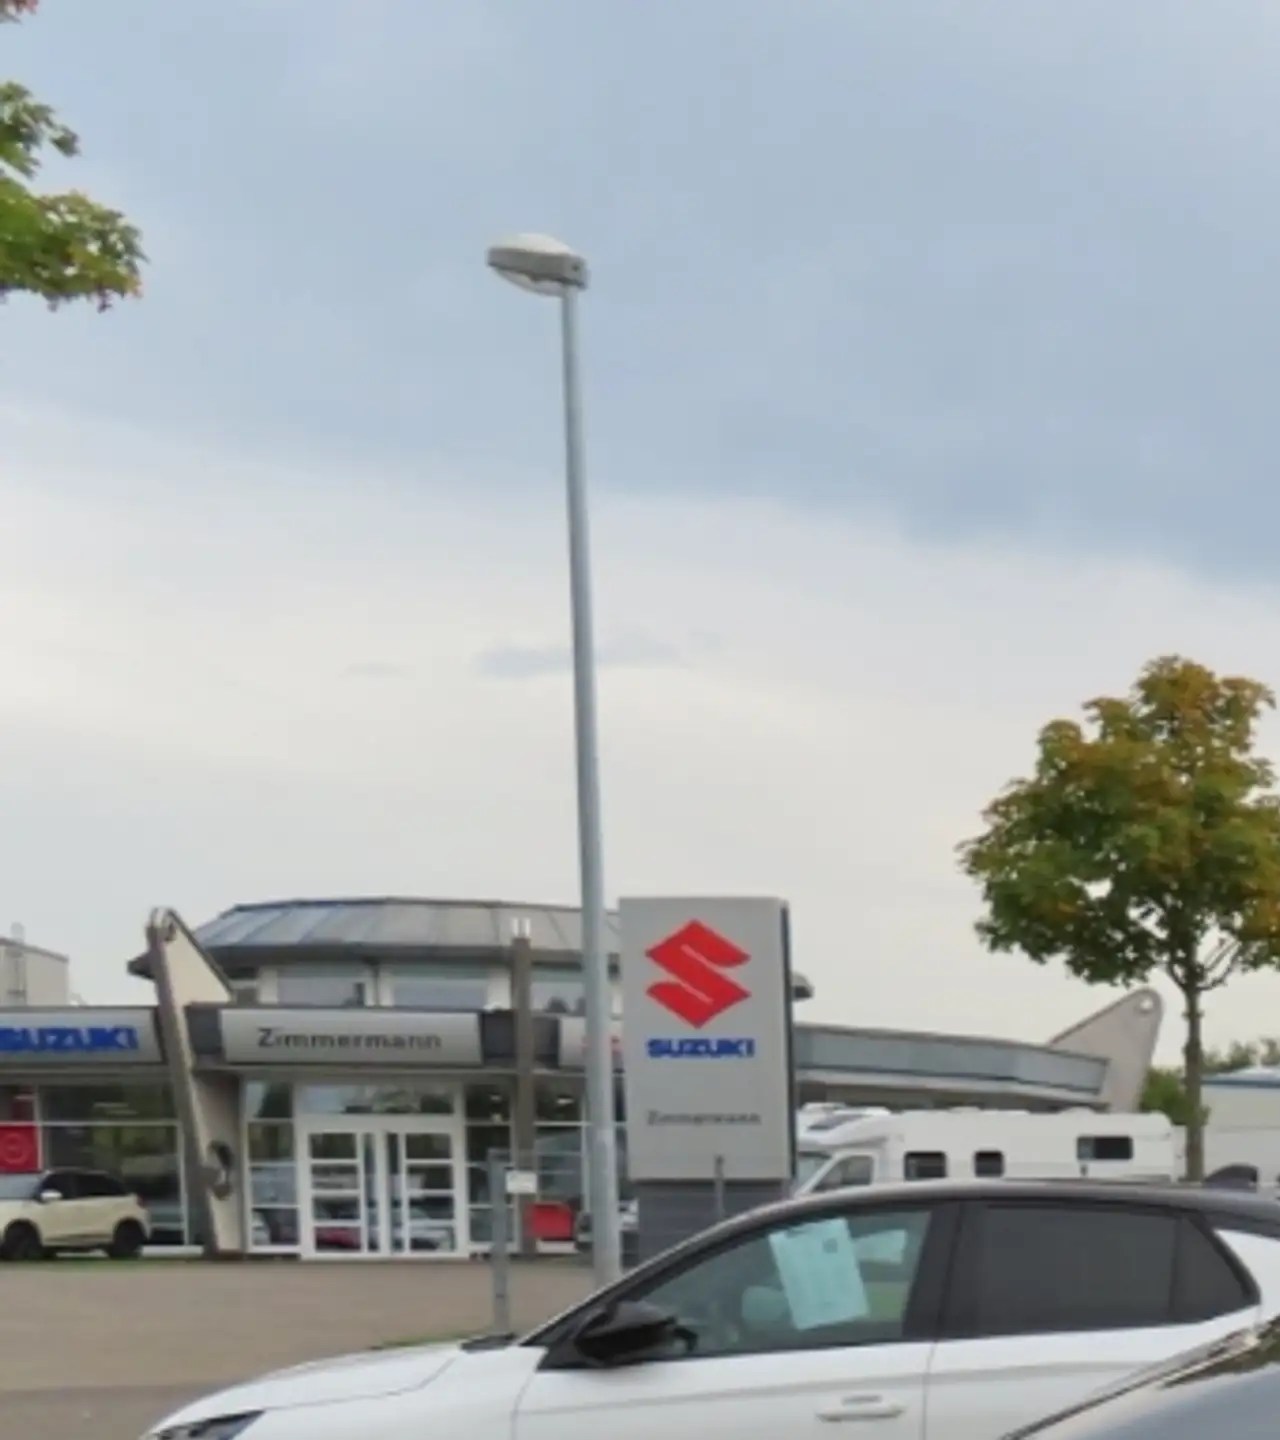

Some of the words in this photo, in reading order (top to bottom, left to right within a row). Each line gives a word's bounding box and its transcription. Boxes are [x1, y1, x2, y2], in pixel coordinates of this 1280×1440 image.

[257, 1027, 442, 1048] Zimmermann
[646, 1037, 756, 1058] SUZUKI
[646, 1109, 762, 1126] Zimmermann
